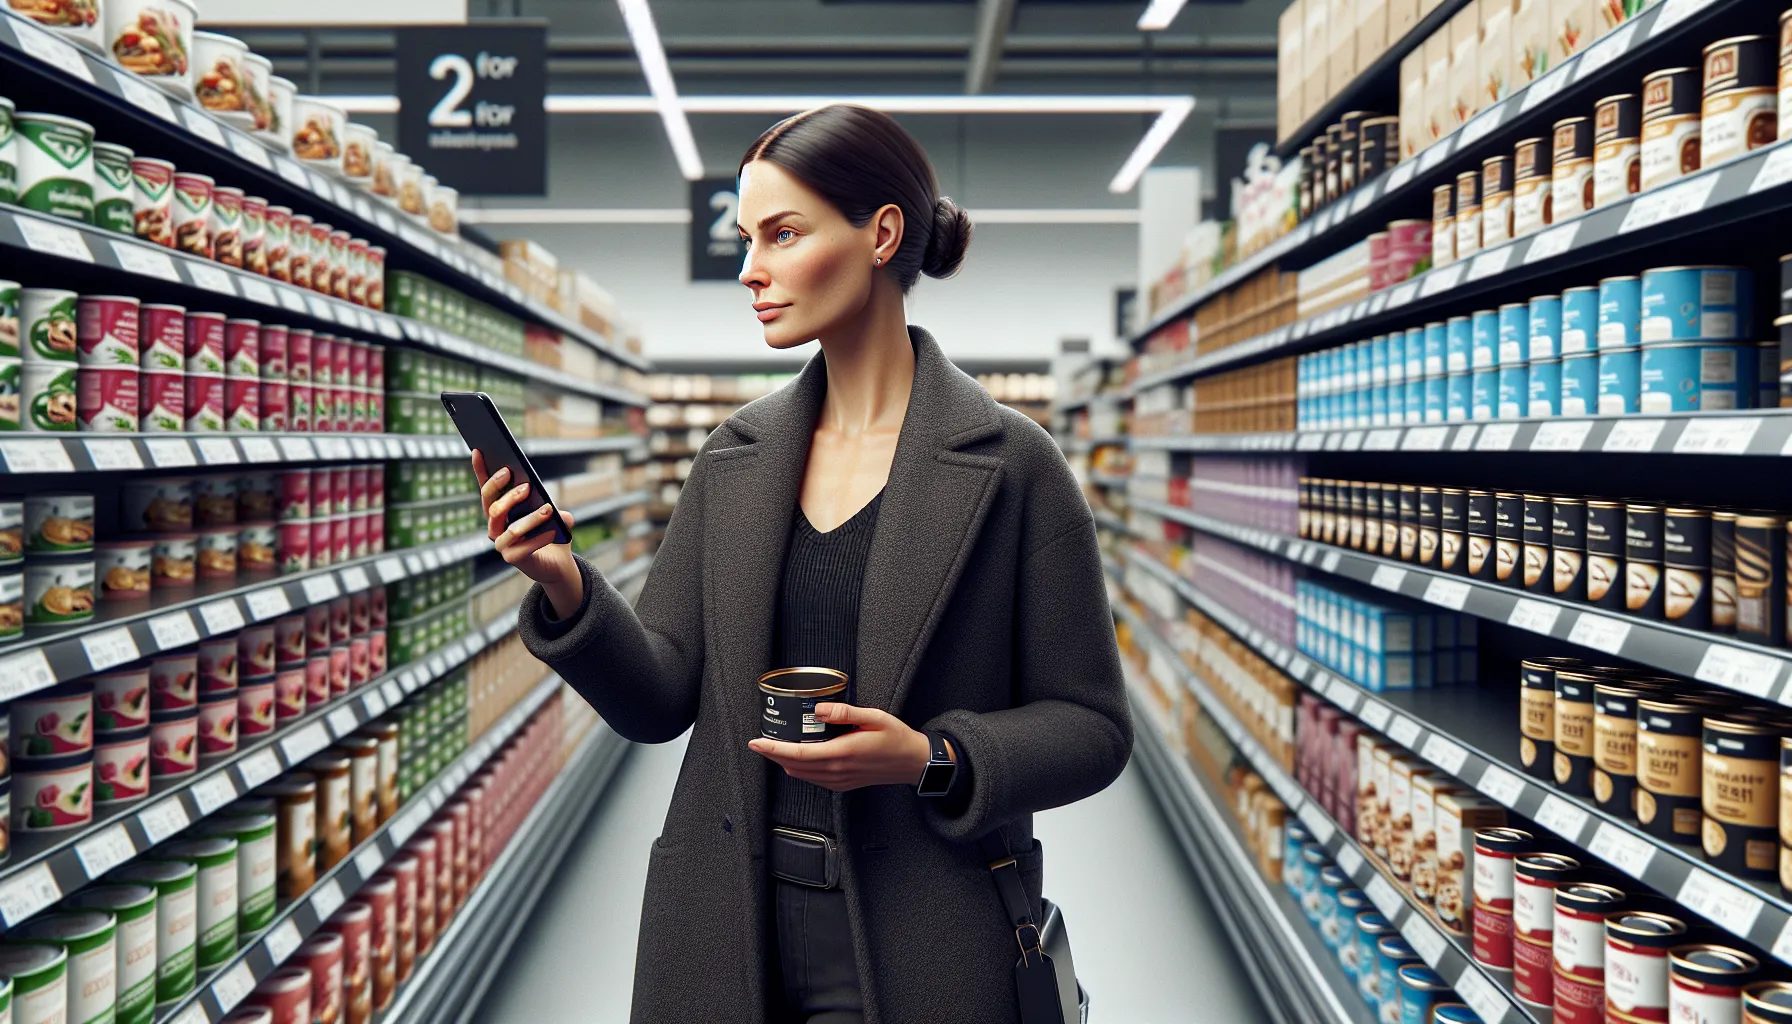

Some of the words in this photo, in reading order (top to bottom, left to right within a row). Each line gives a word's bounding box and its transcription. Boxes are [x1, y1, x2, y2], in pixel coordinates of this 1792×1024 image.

[428, 53, 474, 127] 2
[476, 51, 518, 80] for
[476, 100, 515, 127] for
[709, 190, 739, 240] 2
